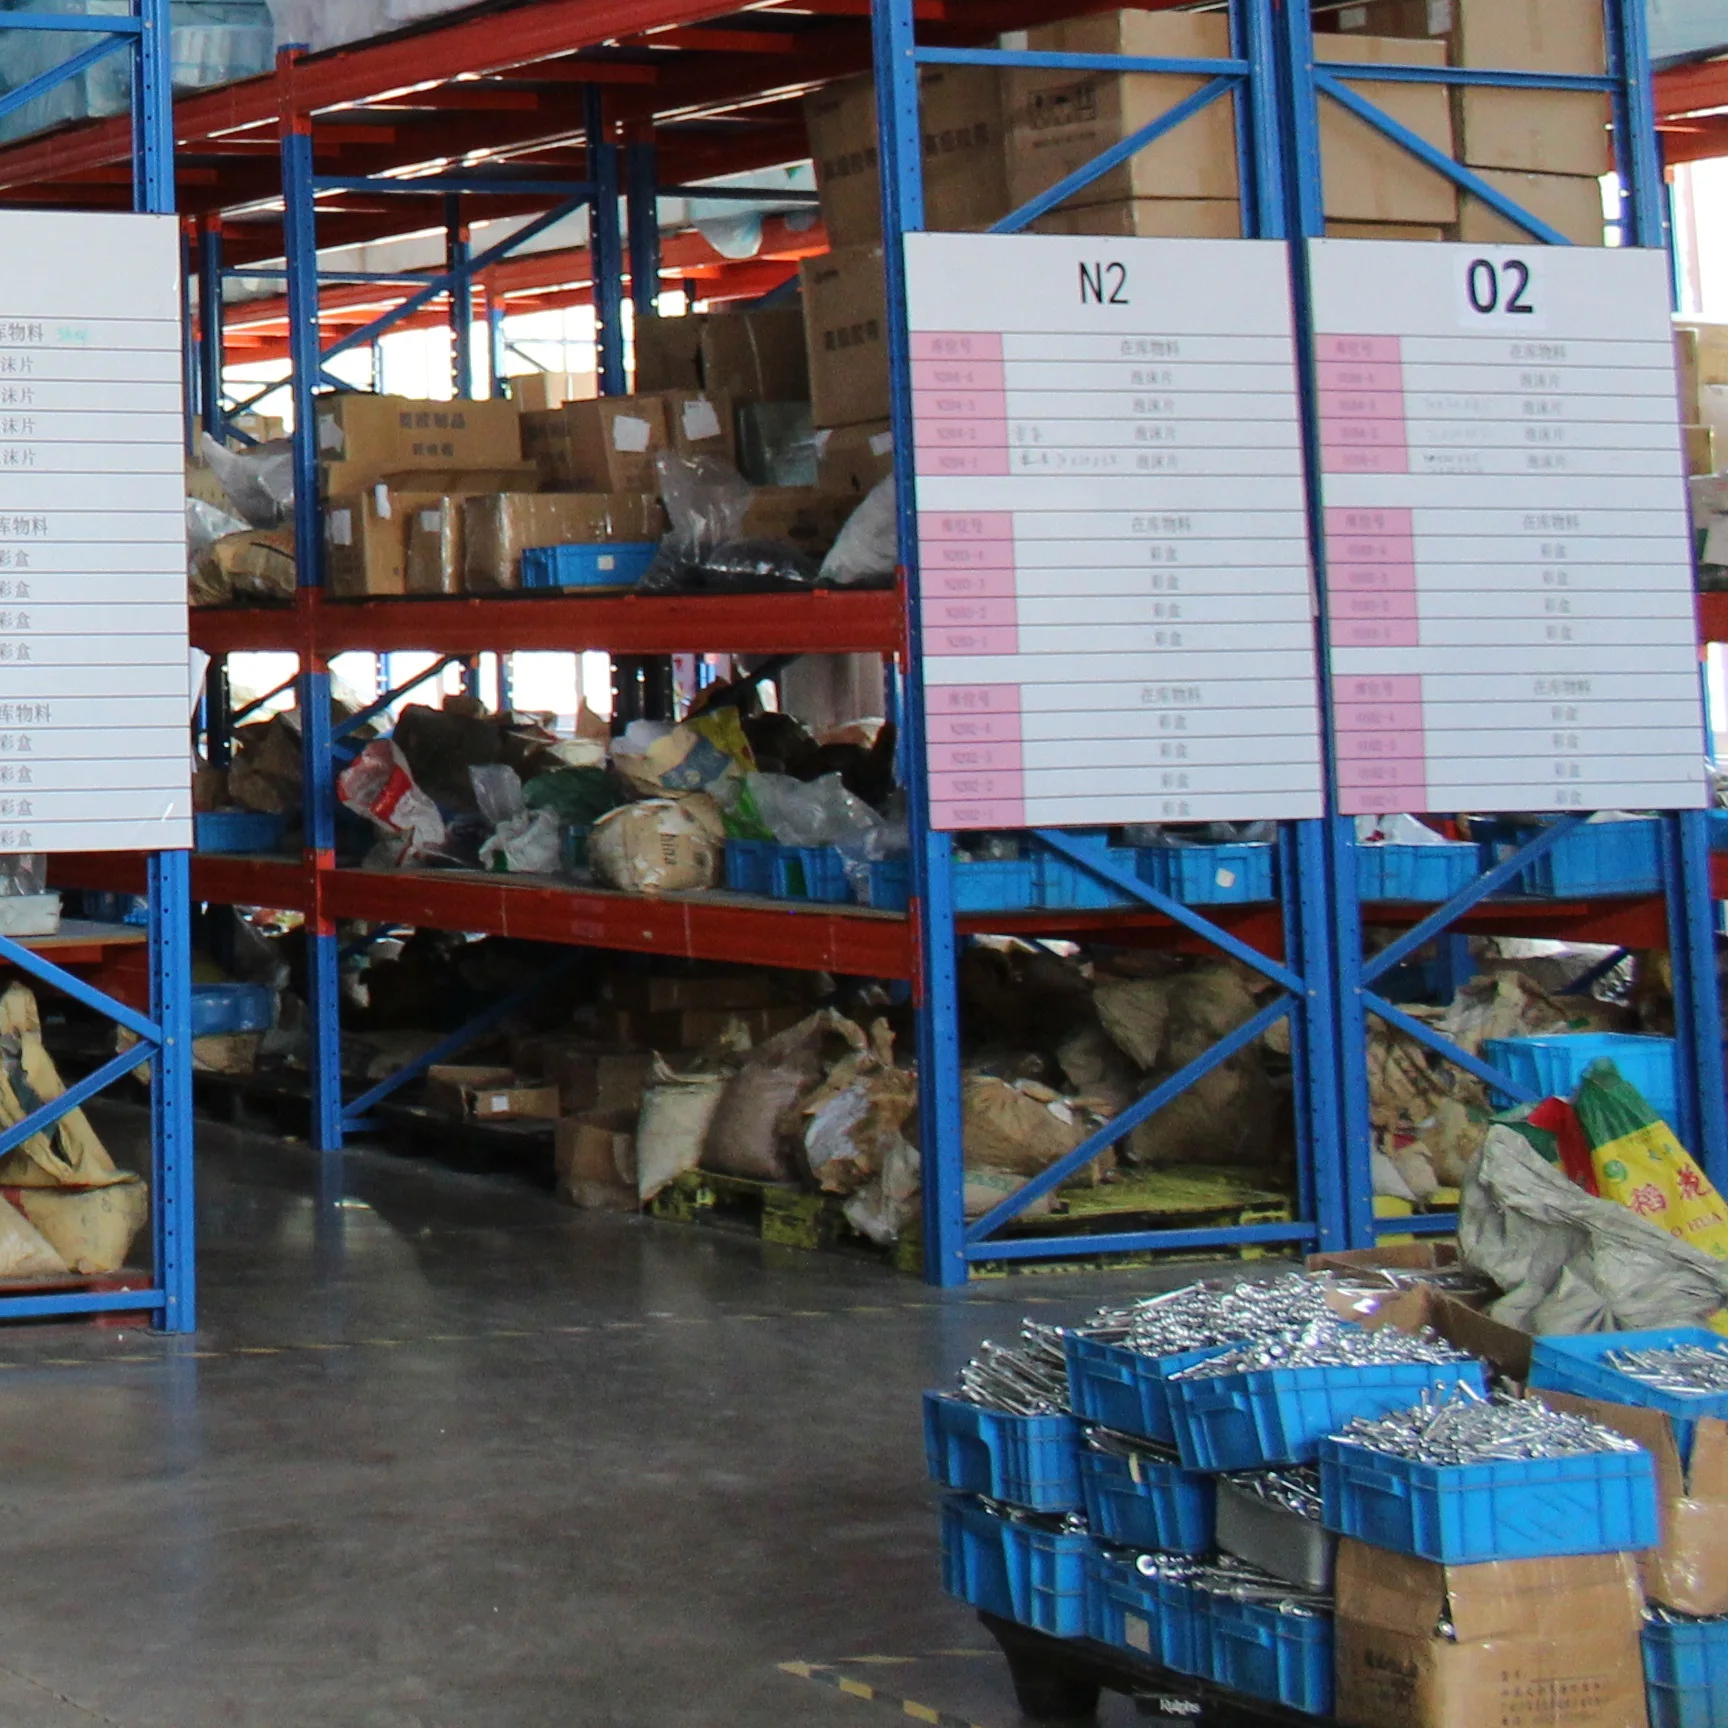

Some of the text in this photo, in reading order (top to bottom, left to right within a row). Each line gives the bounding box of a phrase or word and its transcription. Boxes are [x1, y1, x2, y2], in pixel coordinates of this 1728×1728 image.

[1079, 262, 1128, 304] N2
[0, 643, 30, 660] 彩盒
[0, 734, 31, 751] 彩盒
[0, 765, 32, 783] 彩盒
[0, 799, 32, 816] 彩盒
[0, 830, 32, 847] 彩盒
[660, 833, 678, 865] hina
